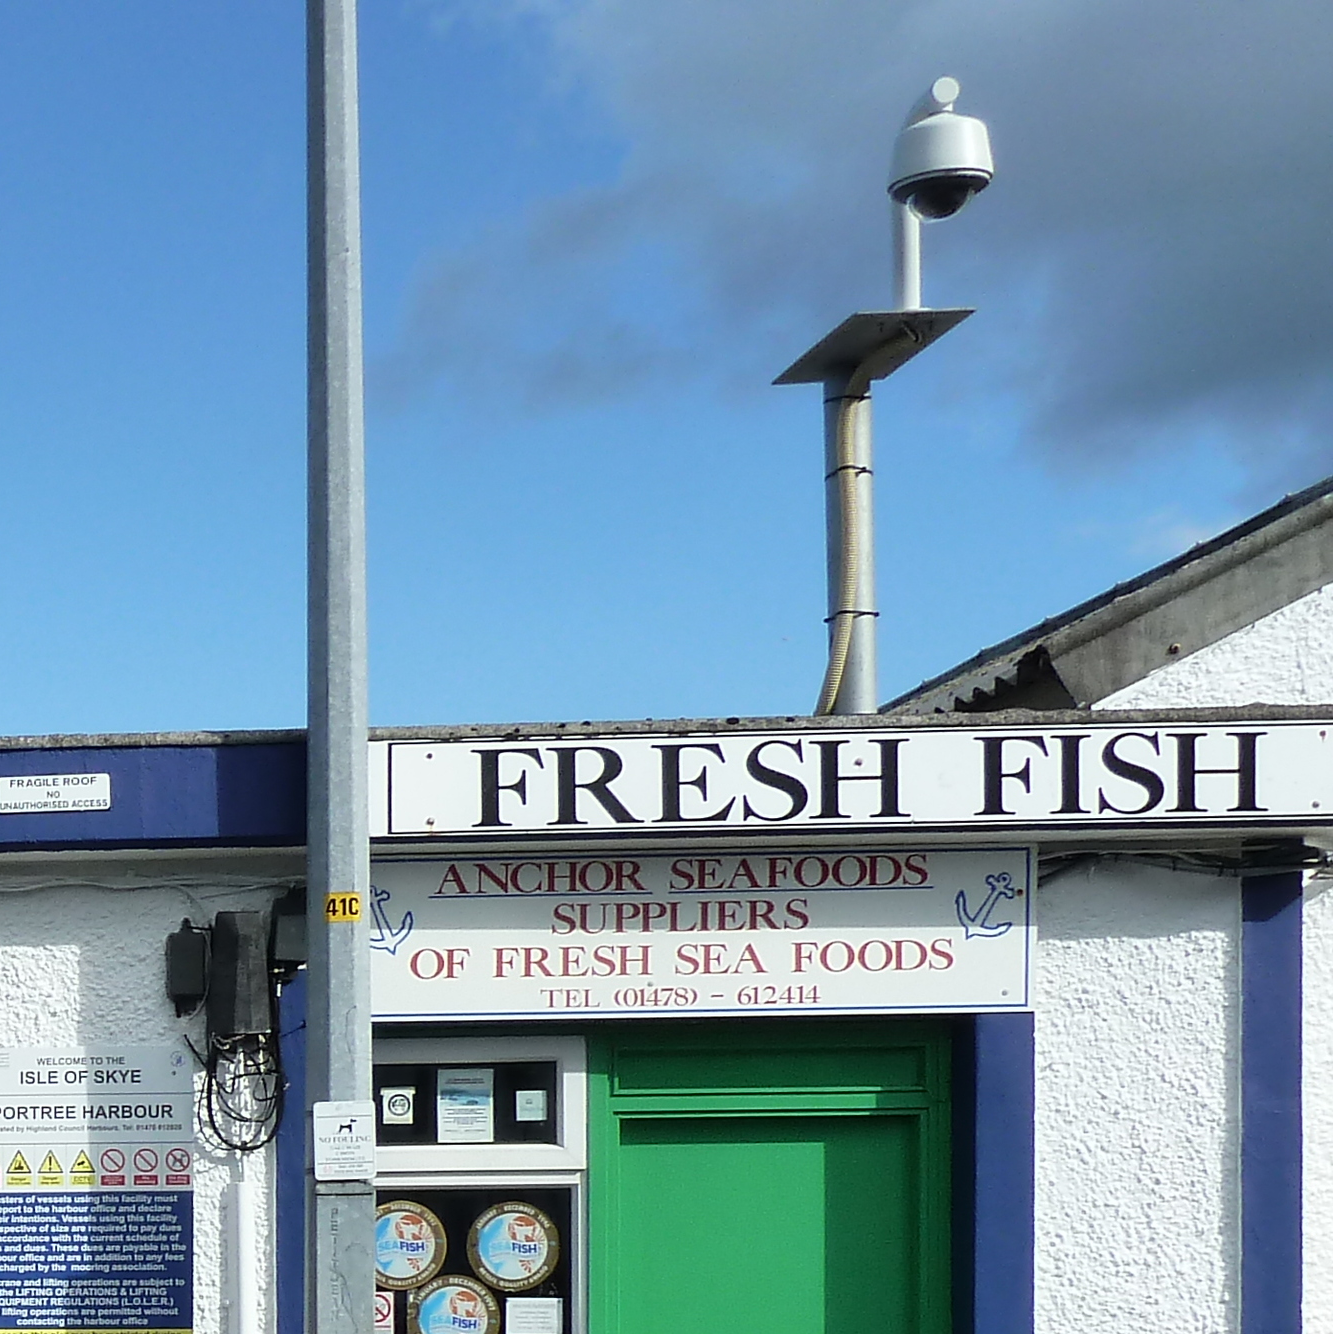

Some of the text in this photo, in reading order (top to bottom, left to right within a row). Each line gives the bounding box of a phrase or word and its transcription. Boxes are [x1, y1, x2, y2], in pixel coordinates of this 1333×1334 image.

[10, 777, 97, 788] FRAGILE ROOF
[471, 731, 1267, 827] FRESH FISH
[0, 799, 107, 810] UNAUTHORISED ACCESS
[436, 854, 930, 895] ANCHOR SEAFOODS
[326, 898, 359, 916] 41C
[551, 898, 809, 935] SUPPLIERS
[410, 939, 954, 980] OF FRESH SEA FOODS
[540, 988, 601, 1009] TEL
[613, 986, 698, 1009] (01478)
[737, 984, 821, 1006] 612414
[90, 1057, 103, 1065] TO
[106, 1057, 125, 1065] THE
[20, 1070, 141, 1084] ISLE OF SKYE
[83, 1105, 173, 1118] HARBOUR
[74, 1196, 99, 1205] using
[102, 1195, 119, 1203] this
[122, 1195, 152, 1204] facility
[155, 1195, 177, 1203] must
[35, 1205, 49, 1213] the
[52, 1205, 88, 1213] harbour
[91, 1205, 115, 1213] office
[99, 1215, 124, 1224] using
[127, 1214, 144, 1222] this
[147, 1214, 177, 1223] facility
[88, 1224, 126, 1233] required
[141, 1225, 157, 1233] pay
[52, 1234, 71, 1242] with
[73, 1234, 88, 1242] the
[126, 1233, 167, 1241] schedule
[170, 1233, 179, 1241] of
[5, 1244, 21, 1252] and
[123, 1243, 158, 1253] payable
[161, 1243, 169, 1251] in
[172, 1243, 186, 1251] the
[19, 1254, 44, 1262] office
[95, 1253, 132, 1261] addition
[146, 1254, 162, 1263] any
[38, 1263, 49, 1272] by
[52, 1263, 66, 1271] the
[71, 1264, 109, 1272] mooring
[24, 1279, 41, 1287] and
[43, 1279, 68, 1288] lifting
[71, 1279, 120, 1287] operations
[140, 1278, 173, 1287] subject
[176, 1278, 185, 1286] to
[16, 1288, 52, 1296] LIFTING
[55, 1288, 117, 1296] OPERATIONS
[51, 1298, 119, 1306] REGULATIONS
[2, 1308, 28, 1317] lifting
[30, 1308, 78, 1316] operations
[98, 1307, 141, 1316] permitted
[144, 1307, 178, 1315] without
[17, 1317, 148, 1326] contacting the harbour office
